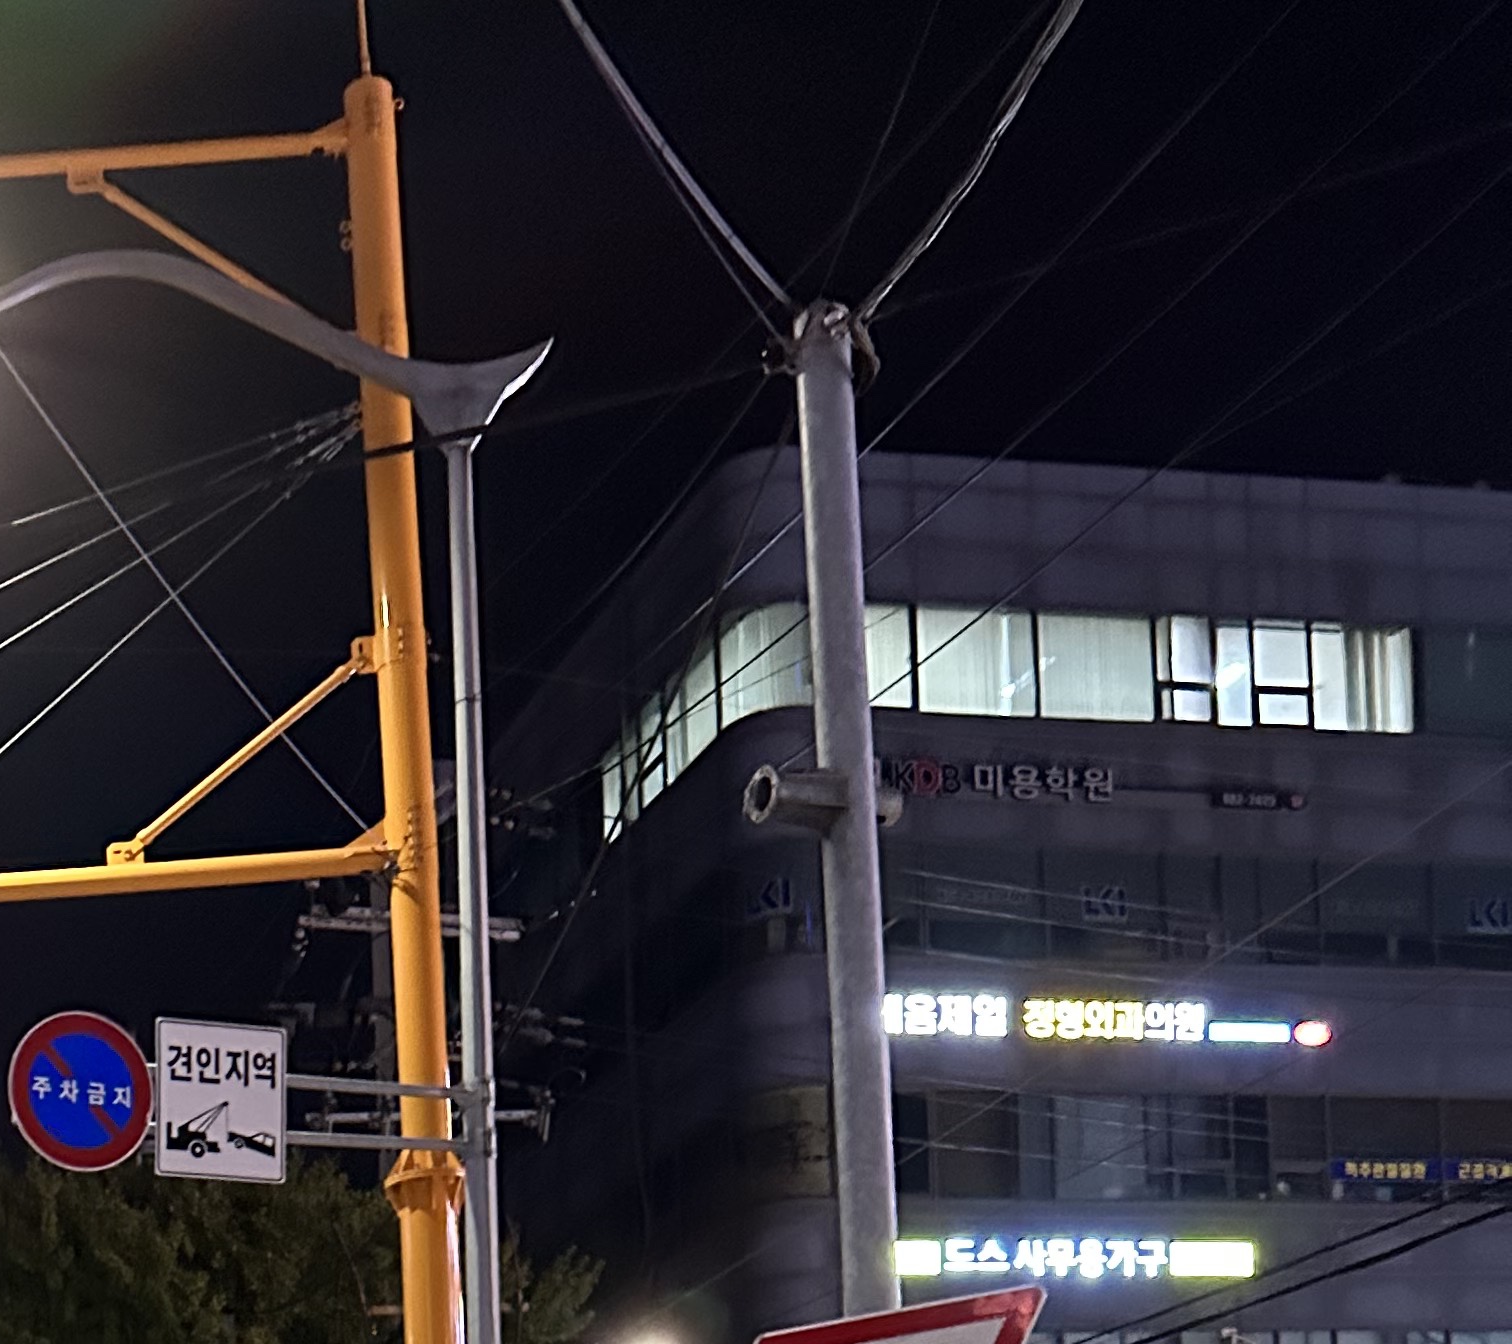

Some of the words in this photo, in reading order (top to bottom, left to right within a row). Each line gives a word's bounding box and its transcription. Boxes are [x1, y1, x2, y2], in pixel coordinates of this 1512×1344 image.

[972, 763, 1115, 803] 미용학원
[1022, 997, 1206, 1042] 정형외과의원
[166, 1043, 278, 1090] 견인지역
[1013, 1237, 1170, 1280] 사무용가구
